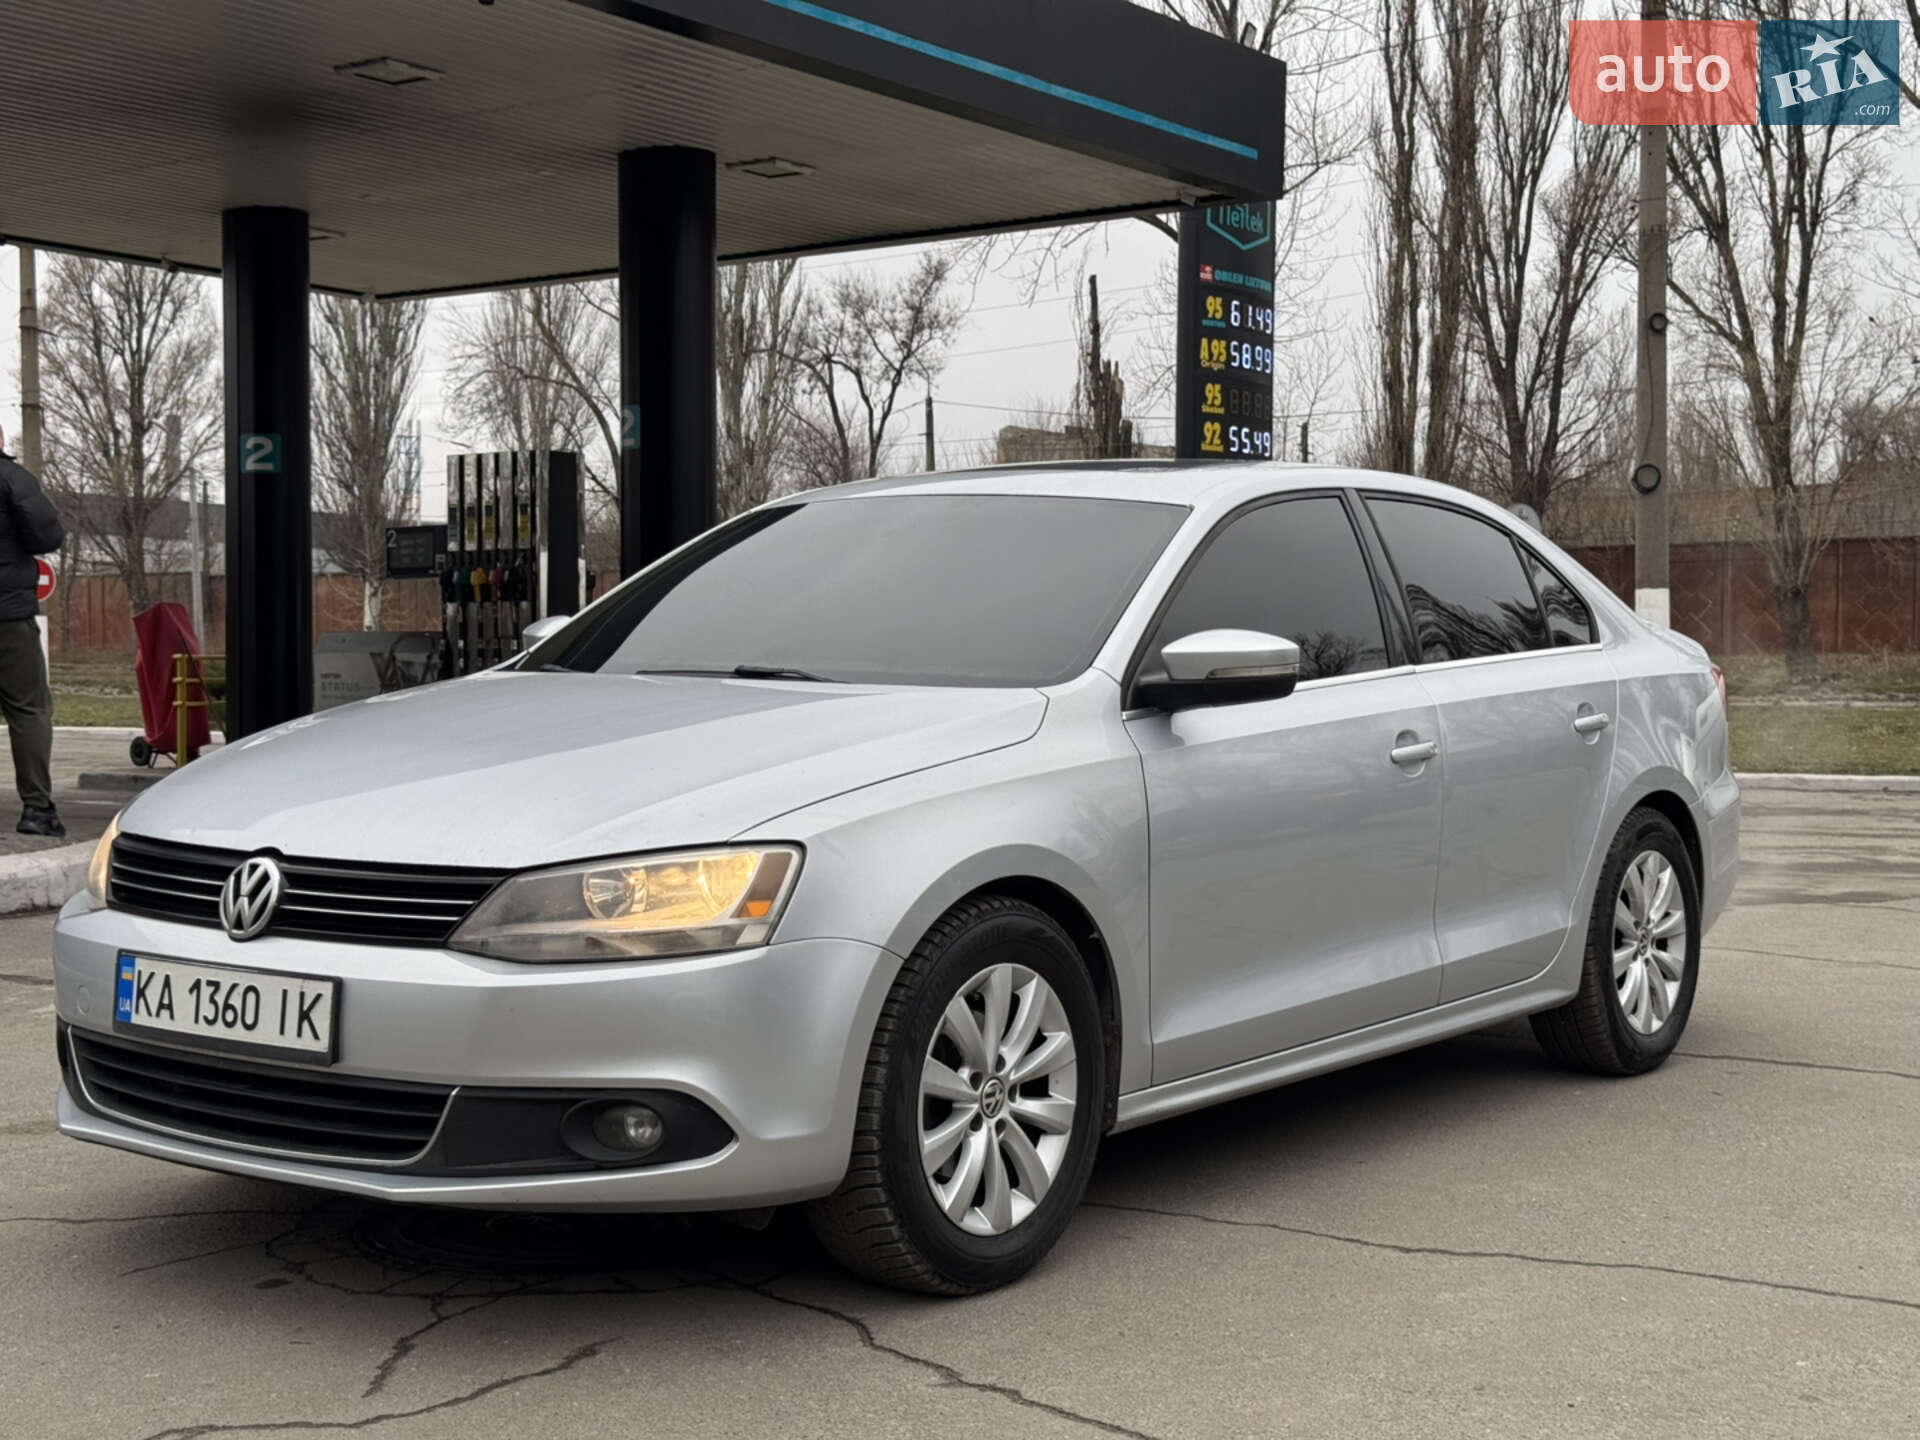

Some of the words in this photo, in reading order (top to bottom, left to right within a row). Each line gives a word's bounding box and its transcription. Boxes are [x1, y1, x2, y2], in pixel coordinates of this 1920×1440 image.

[1206, 296, 1223, 319] 95
[1230, 341, 1271, 374] 58.99
[1205, 383, 1221, 406] 95
[1204, 421, 1221, 445] 92
[1229, 425, 1270, 456] 55.49
[246, 436, 274, 470] 2
[387, 529, 397, 547] 2
[119, 997, 131, 1012] UA
[135, 969, 175, 1020] KA
[188, 978, 261, 1031] 1360
[279, 988, 323, 1041] IK
